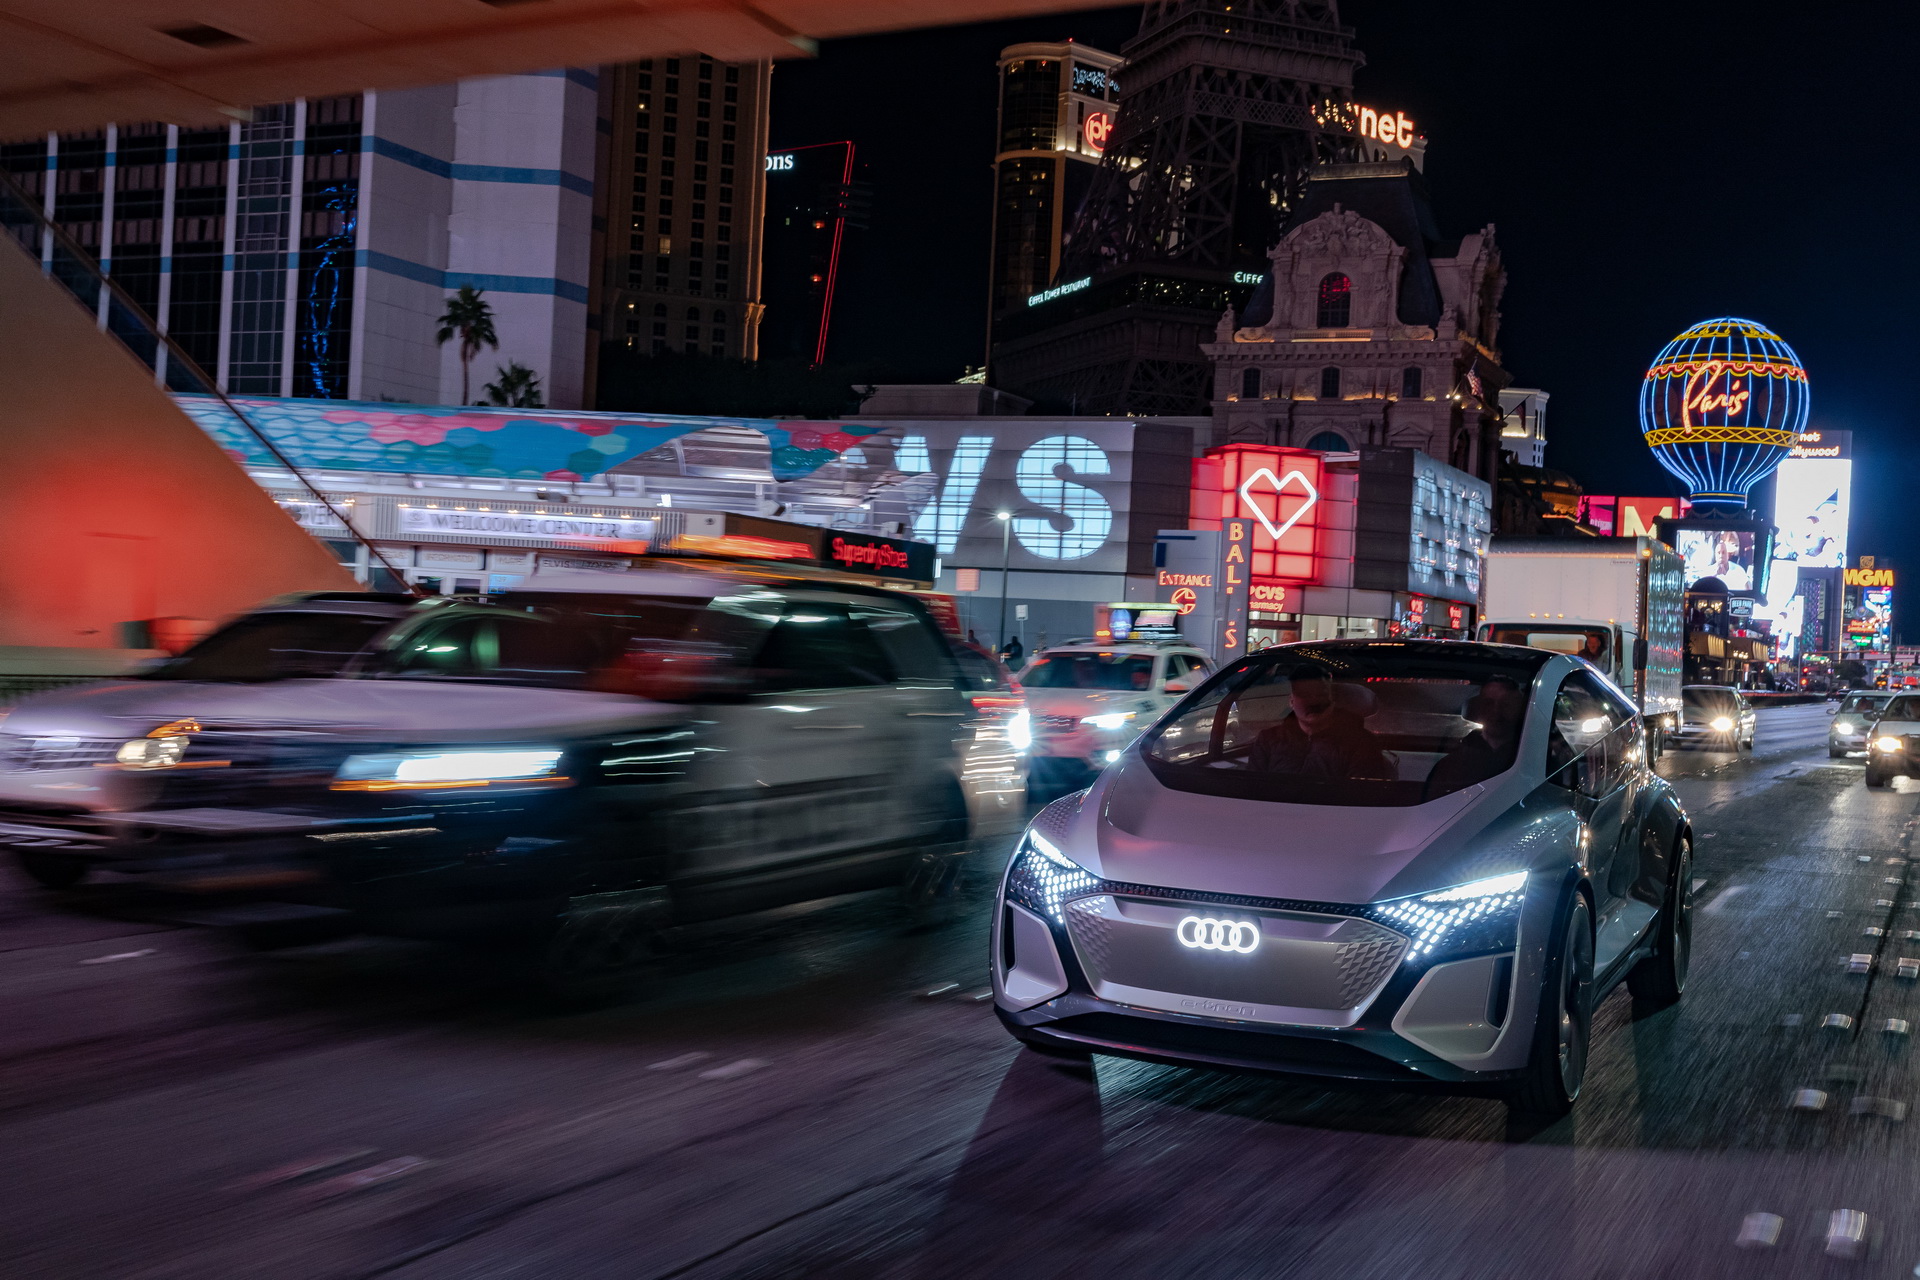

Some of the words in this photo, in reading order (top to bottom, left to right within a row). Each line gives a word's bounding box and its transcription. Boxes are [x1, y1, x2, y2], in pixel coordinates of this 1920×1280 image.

[1682, 359, 1750, 434] Paris
[1799, 431, 1821, 442] net
[1789, 445, 1840, 459] ollywood
[891, 434, 1113, 561] VS
[430, 513, 537, 534] WELCOME
[538, 519, 622, 538] CENTER
[1158, 570, 1212, 587] ENTRANCE
[1844, 568, 1895, 587] MGM
[1254, 585, 1285, 601] CVS
